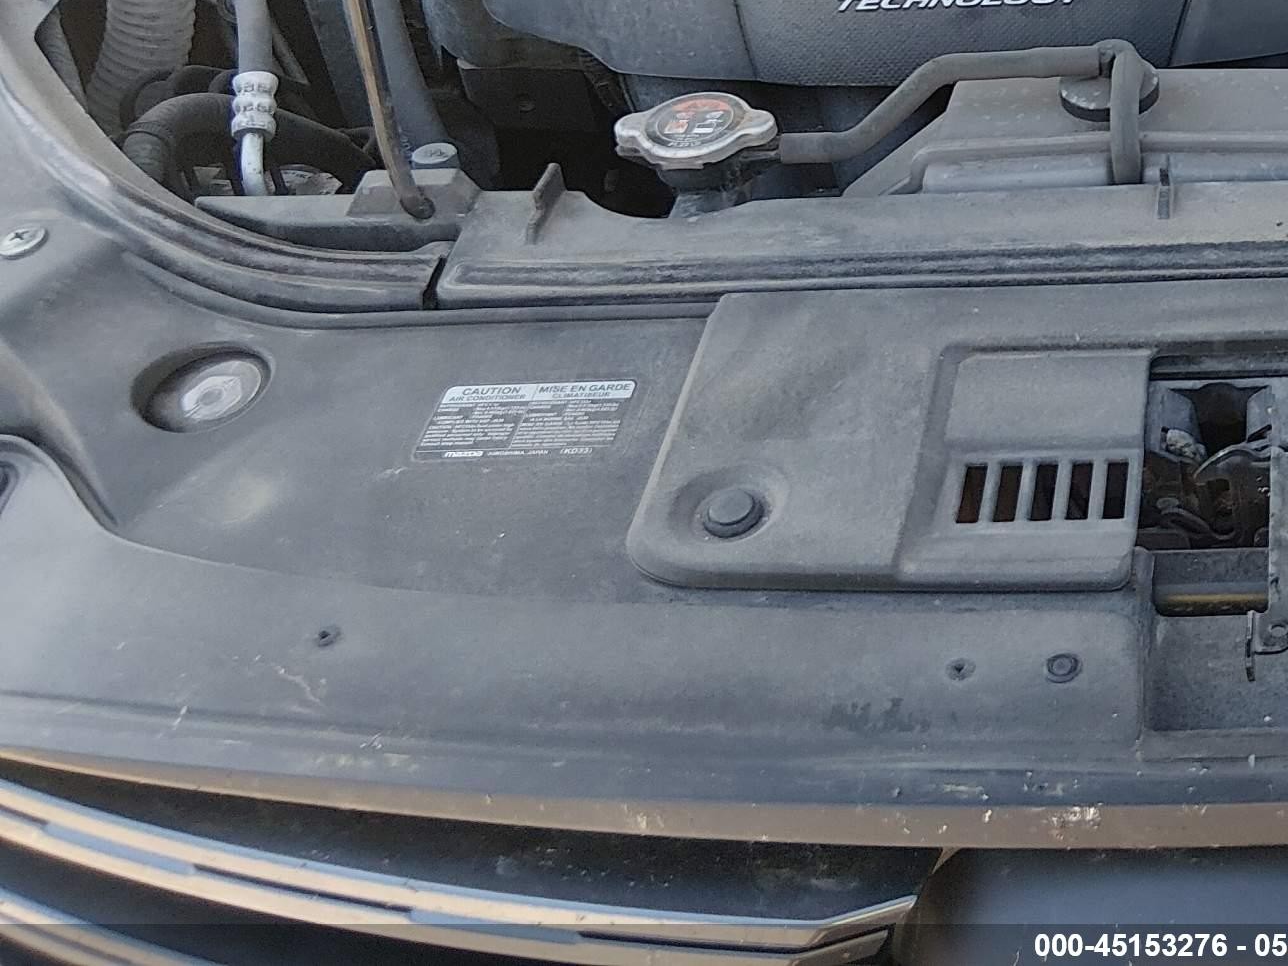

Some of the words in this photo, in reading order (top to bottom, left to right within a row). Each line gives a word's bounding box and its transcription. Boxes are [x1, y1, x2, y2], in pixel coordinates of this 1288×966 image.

[463, 386, 521, 395] CAUTION
[538, 386, 568, 394] MISE
[570, 385, 587, 393] EN
[589, 383, 633, 392] GARDE
